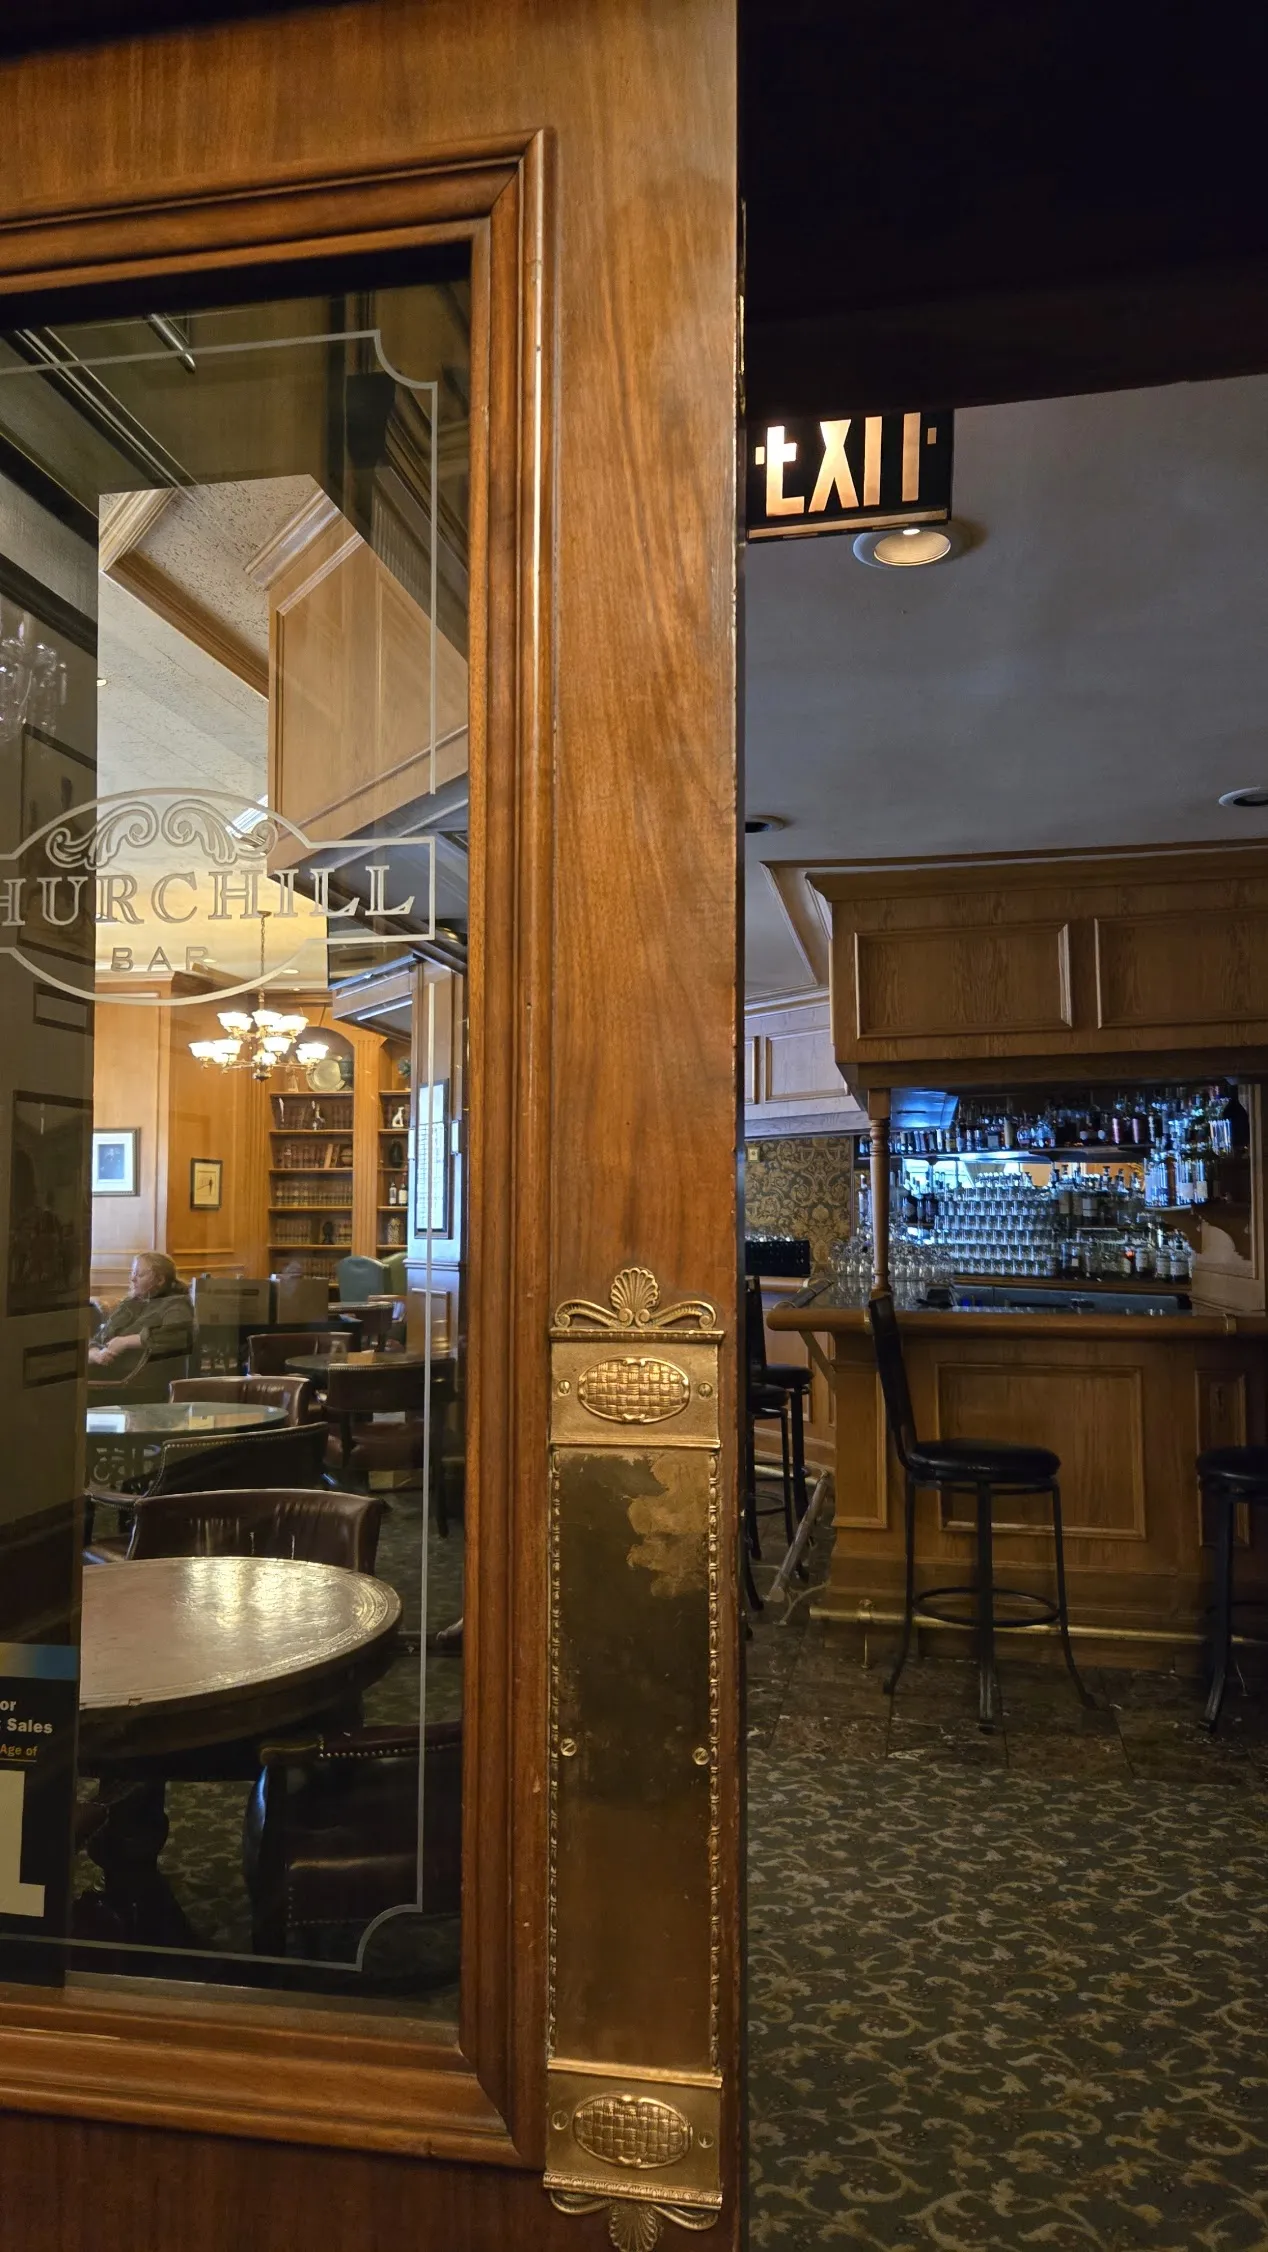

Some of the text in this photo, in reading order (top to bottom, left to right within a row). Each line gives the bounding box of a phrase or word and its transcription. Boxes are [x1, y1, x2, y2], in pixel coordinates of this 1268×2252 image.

[111, 946, 209, 972] BAR
[7, 1717, 53, 1733] Sales
[0, 1743, 37, 1756] Age of
